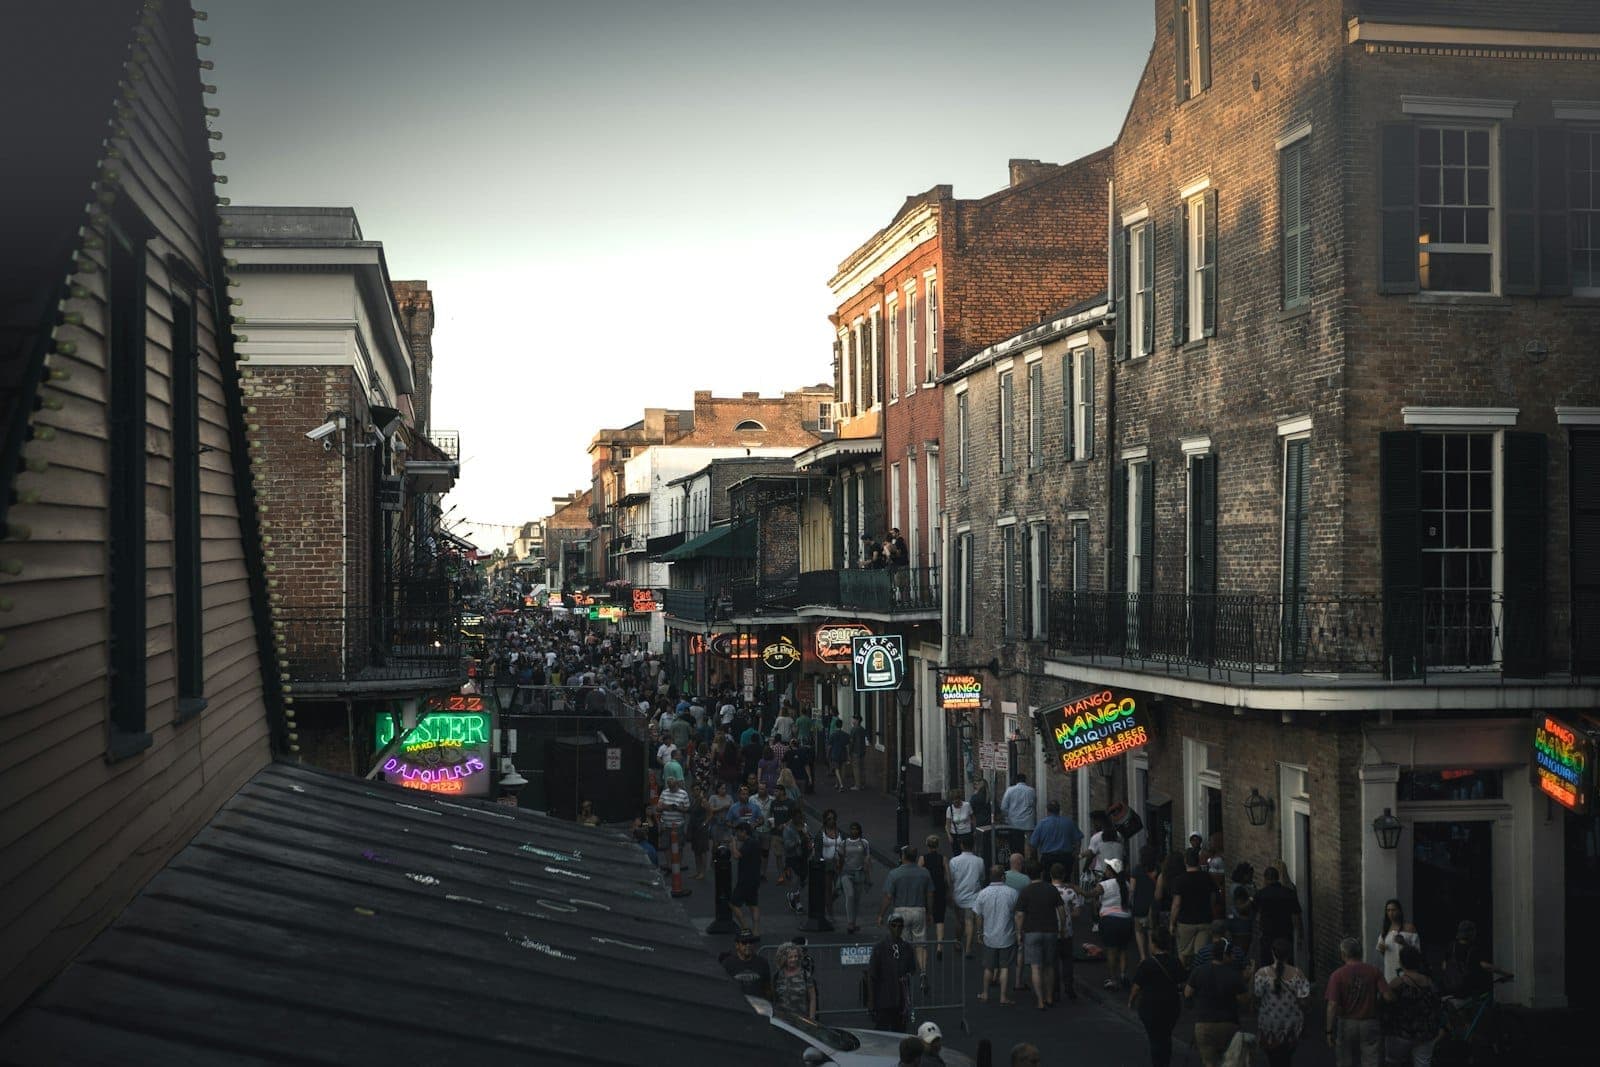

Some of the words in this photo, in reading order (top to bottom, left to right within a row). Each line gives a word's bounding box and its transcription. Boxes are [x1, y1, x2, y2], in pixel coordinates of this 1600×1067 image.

[818, 627, 871, 649] SCOR
[855, 637, 877, 665] BEER
[880, 637, 903, 662] FEST
[941, 682, 982, 694] MANGO
[947, 676, 975, 684] MANGO
[1063, 690, 1112, 718] MANGO
[1055, 697, 1136, 744] MANGO
[1063, 716, 1136, 749] DAIQUIRIS
[406, 741, 437, 752] MARDI
[1063, 740, 1103, 761] COCKTAILS
[1106, 737, 1114, 746] &
[1117, 725, 1146, 742] BEER
[1064, 755, 1088, 771] PIZZA
[1095, 733, 1148, 760] STREETFOOD
[1535, 727, 1585, 773] MANGO
[402, 781, 428, 790] AND
[430, 783, 461, 791] PIZZA
